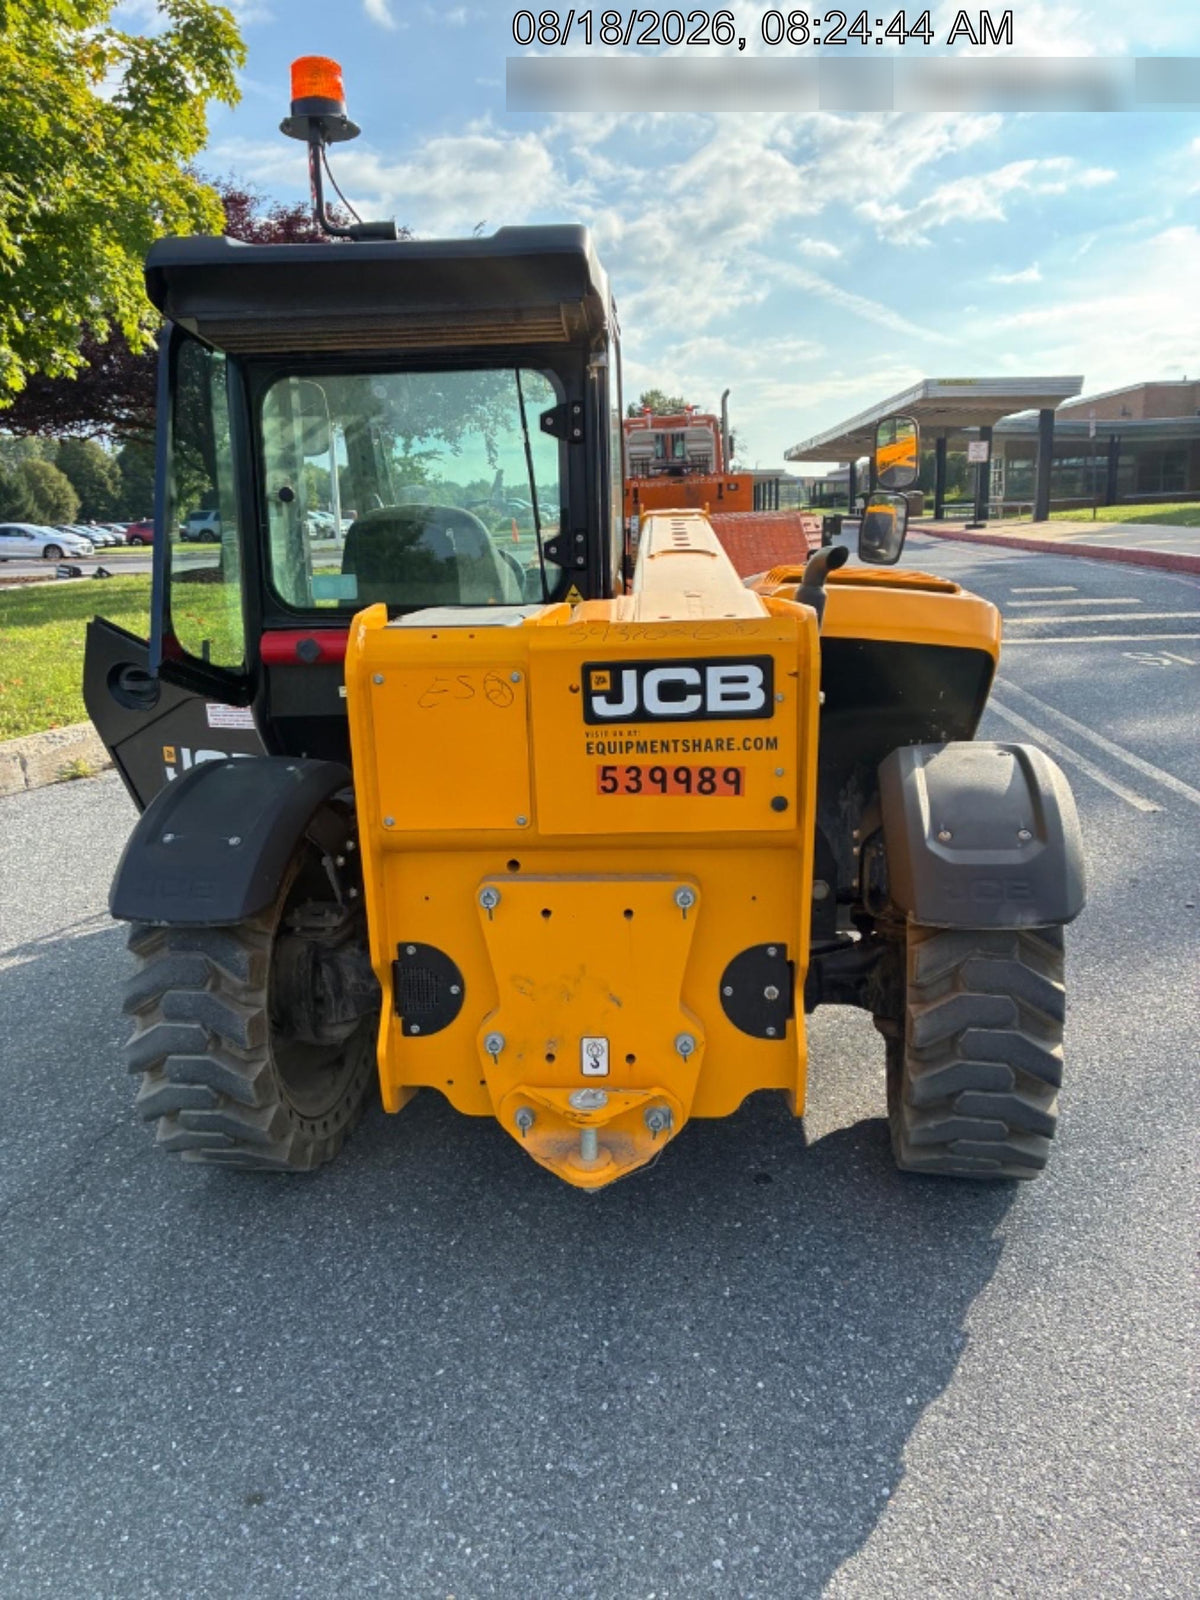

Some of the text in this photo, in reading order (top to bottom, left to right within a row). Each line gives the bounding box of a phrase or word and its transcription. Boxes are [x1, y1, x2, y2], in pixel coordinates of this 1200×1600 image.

[590, 665, 767, 718] JCB
[585, 736, 779, 756] EQUIPMENTSHARE.COM
[599, 765, 742, 796] 539989
